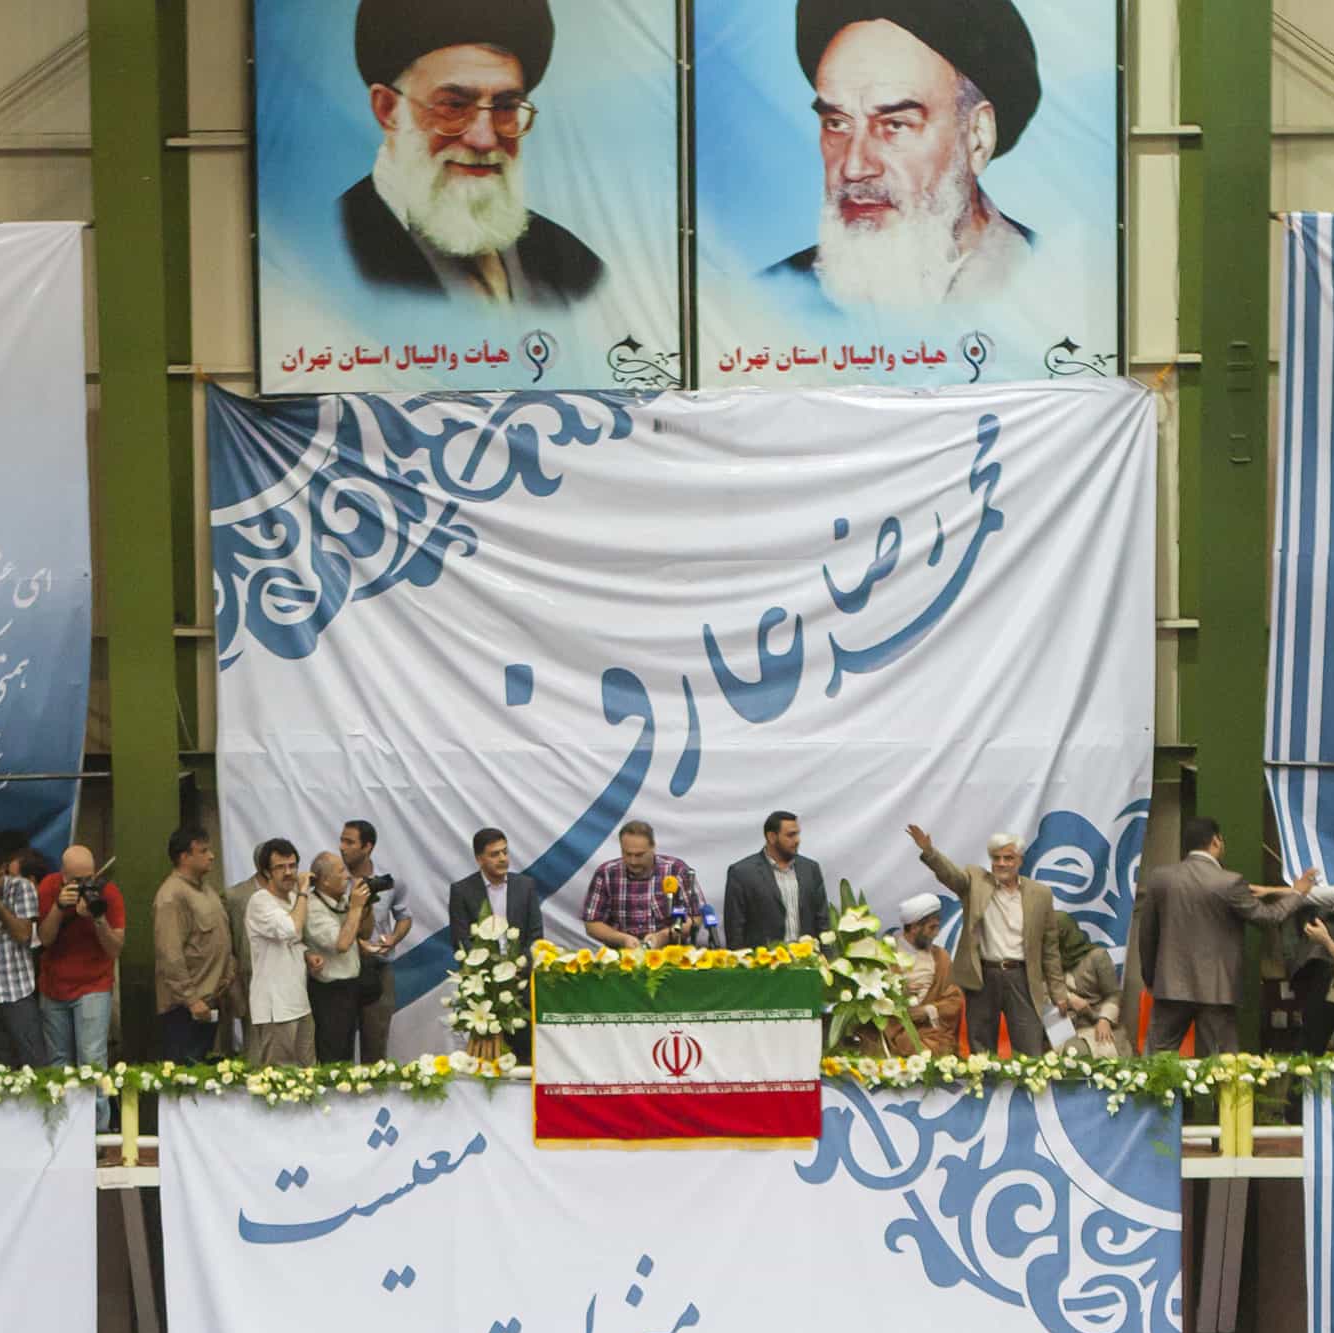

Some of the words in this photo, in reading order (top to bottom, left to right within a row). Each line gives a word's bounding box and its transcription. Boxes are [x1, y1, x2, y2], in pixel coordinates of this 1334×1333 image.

[282, 346, 332, 372] تهران
[338, 345, 389, 370] استان
[396, 344, 459, 370] والیبال
[719, 346, 770, 372] تهران
[776, 345, 827, 371] استان
[833, 344, 895, 370] والیبال
[14, 567, 52, 608] ای
[238, 1107, 487, 1292] معیشت
